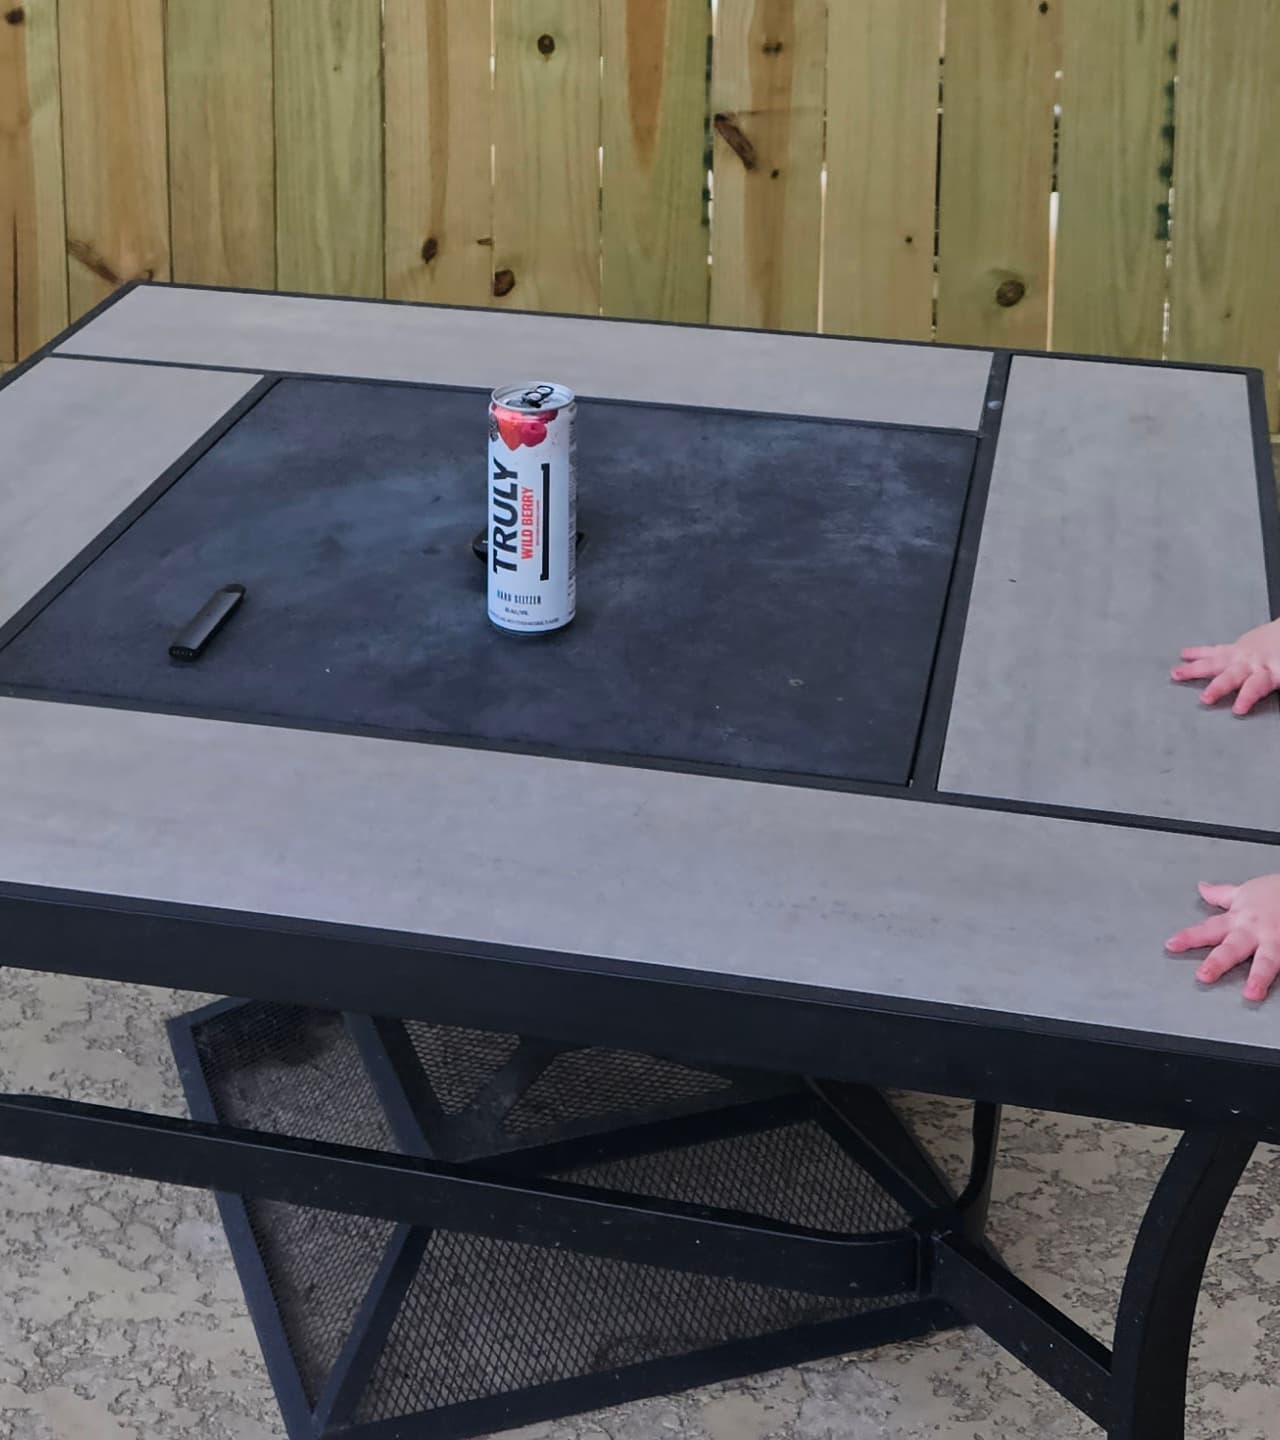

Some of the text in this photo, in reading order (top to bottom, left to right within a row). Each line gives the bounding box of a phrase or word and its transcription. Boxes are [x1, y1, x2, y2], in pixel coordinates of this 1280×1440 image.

[493, 456, 518, 574] TRULY
[521, 486, 534, 560] WILD BERRY
[496, 589, 542, 605] HARD SELTZER
